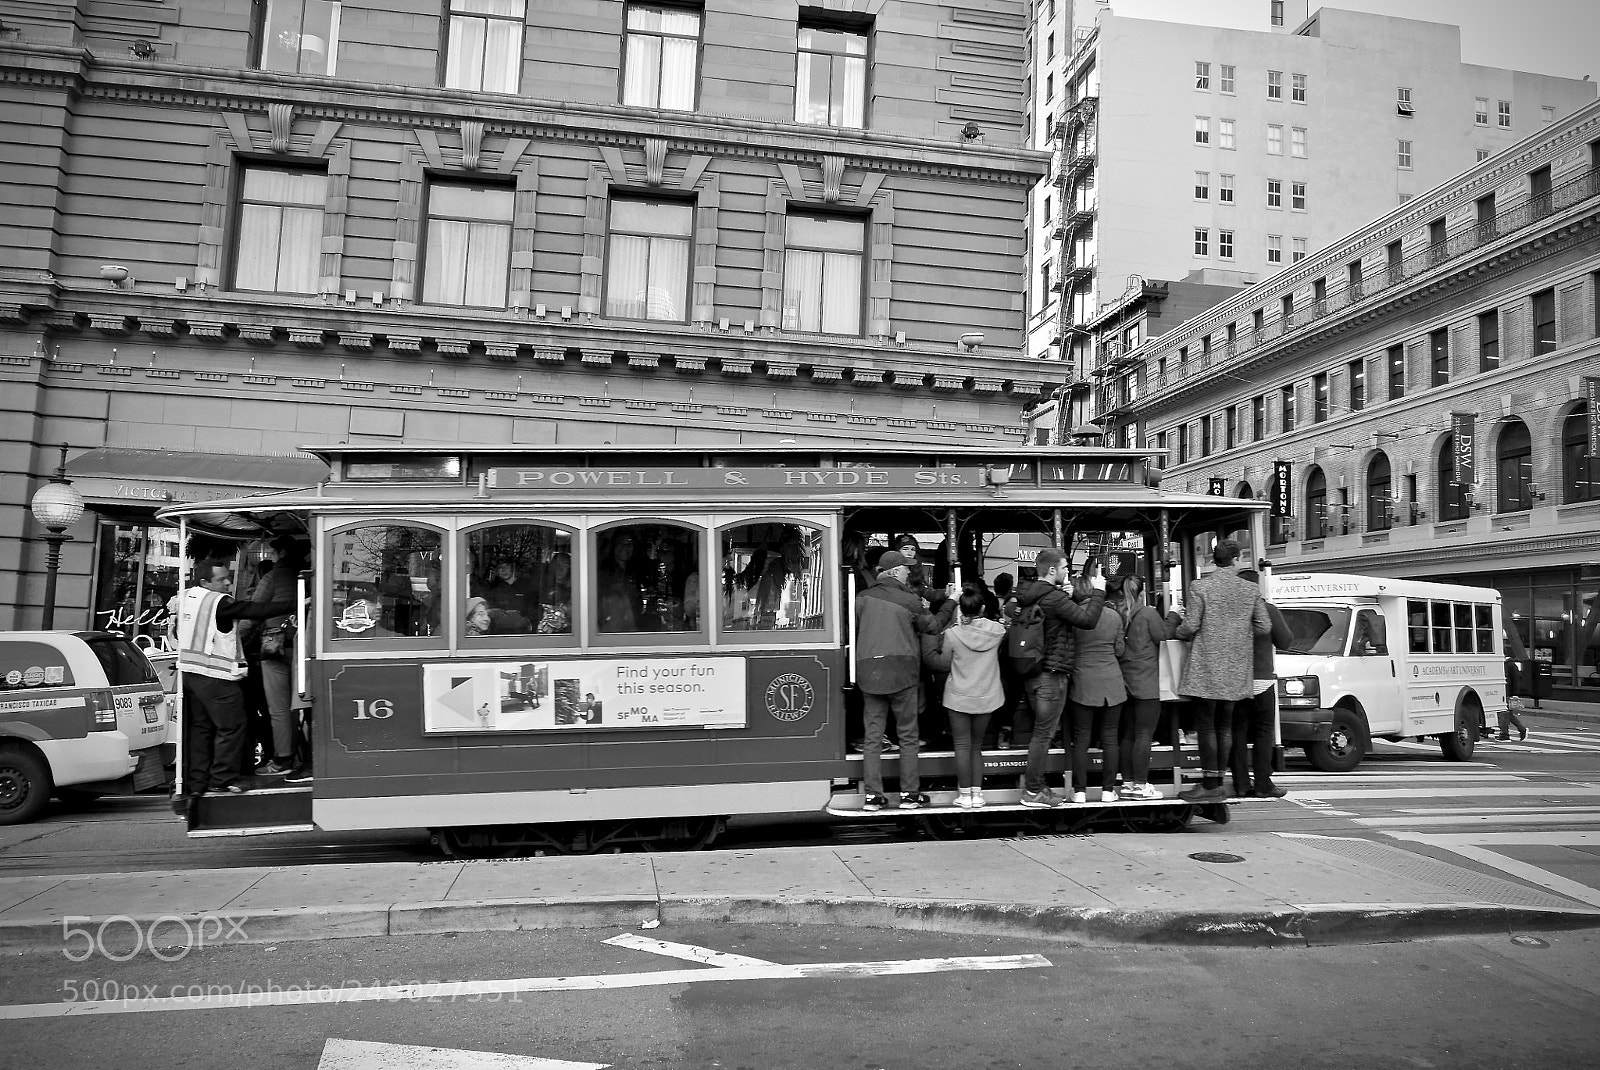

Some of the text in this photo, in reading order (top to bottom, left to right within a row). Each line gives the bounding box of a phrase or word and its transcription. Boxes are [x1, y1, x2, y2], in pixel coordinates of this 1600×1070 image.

[1460, 434, 1472, 469] DSW
[516, 471, 968, 485] POWELL & HYDE Sts.
[1278, 465, 1287, 514] MORTONS
[1018, 549, 1040, 561] MO
[1285, 585, 1301, 593] ART
[1303, 583, 1360, 593] UNIVERSITY
[617, 664, 715, 680] Find your fun
[617, 682, 706, 695] this season.
[767, 675, 812, 695] MUNICIPAL
[115, 697, 133, 710] 9083
[352, 699, 394, 720] 16
[617, 707, 648, 720] SF MO
[641, 715, 659, 723] MA
[768, 704, 810, 720] RAILWAY
